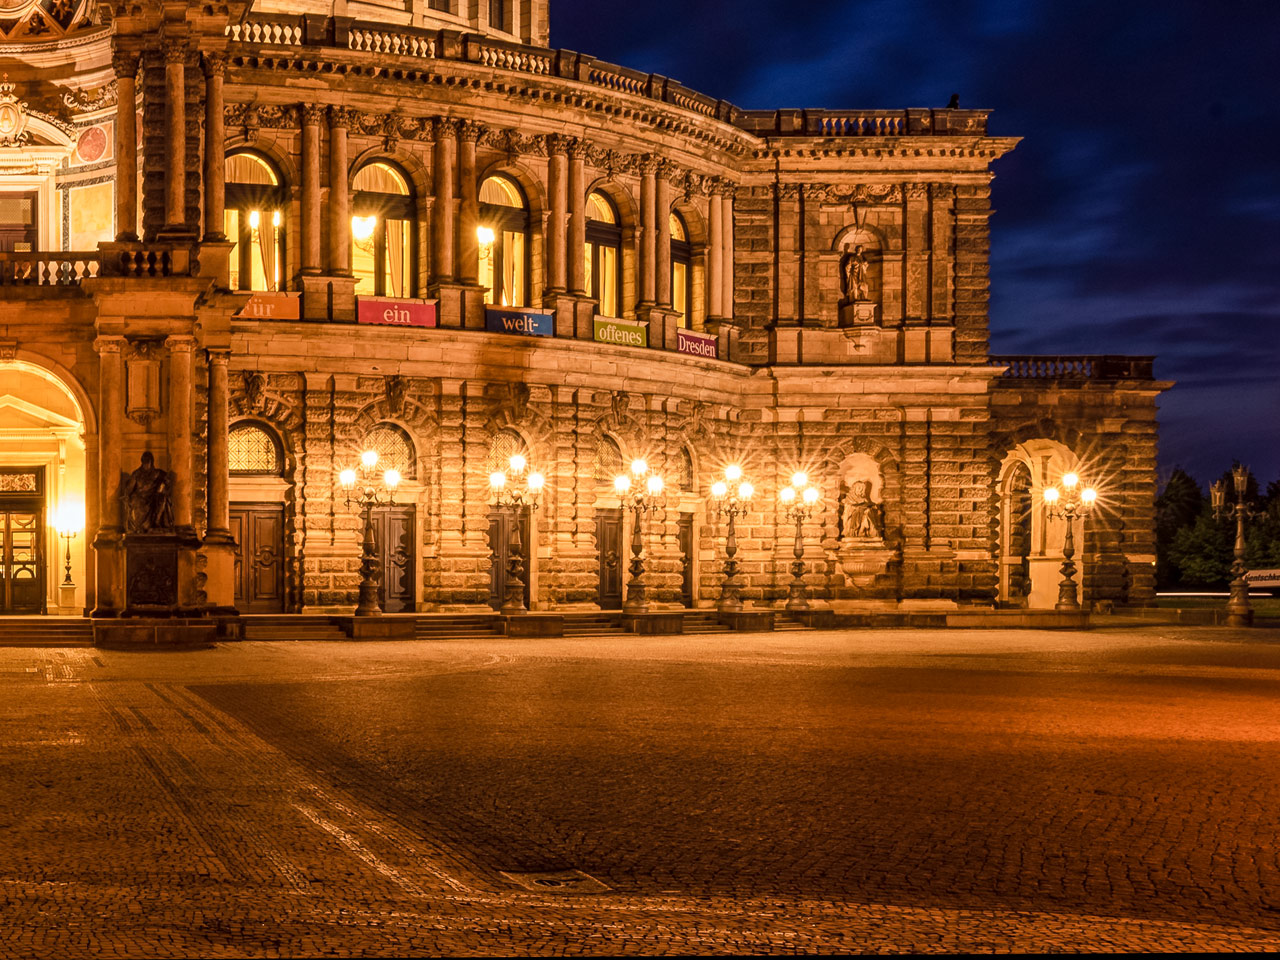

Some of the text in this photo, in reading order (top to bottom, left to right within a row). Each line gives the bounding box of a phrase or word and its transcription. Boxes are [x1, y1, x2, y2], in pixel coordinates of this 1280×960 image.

[383, 305, 411, 323] ein
[501, 315, 539, 333] welt-
[599, 324, 642, 345] offenes
[678, 335, 716, 358] Dresden
